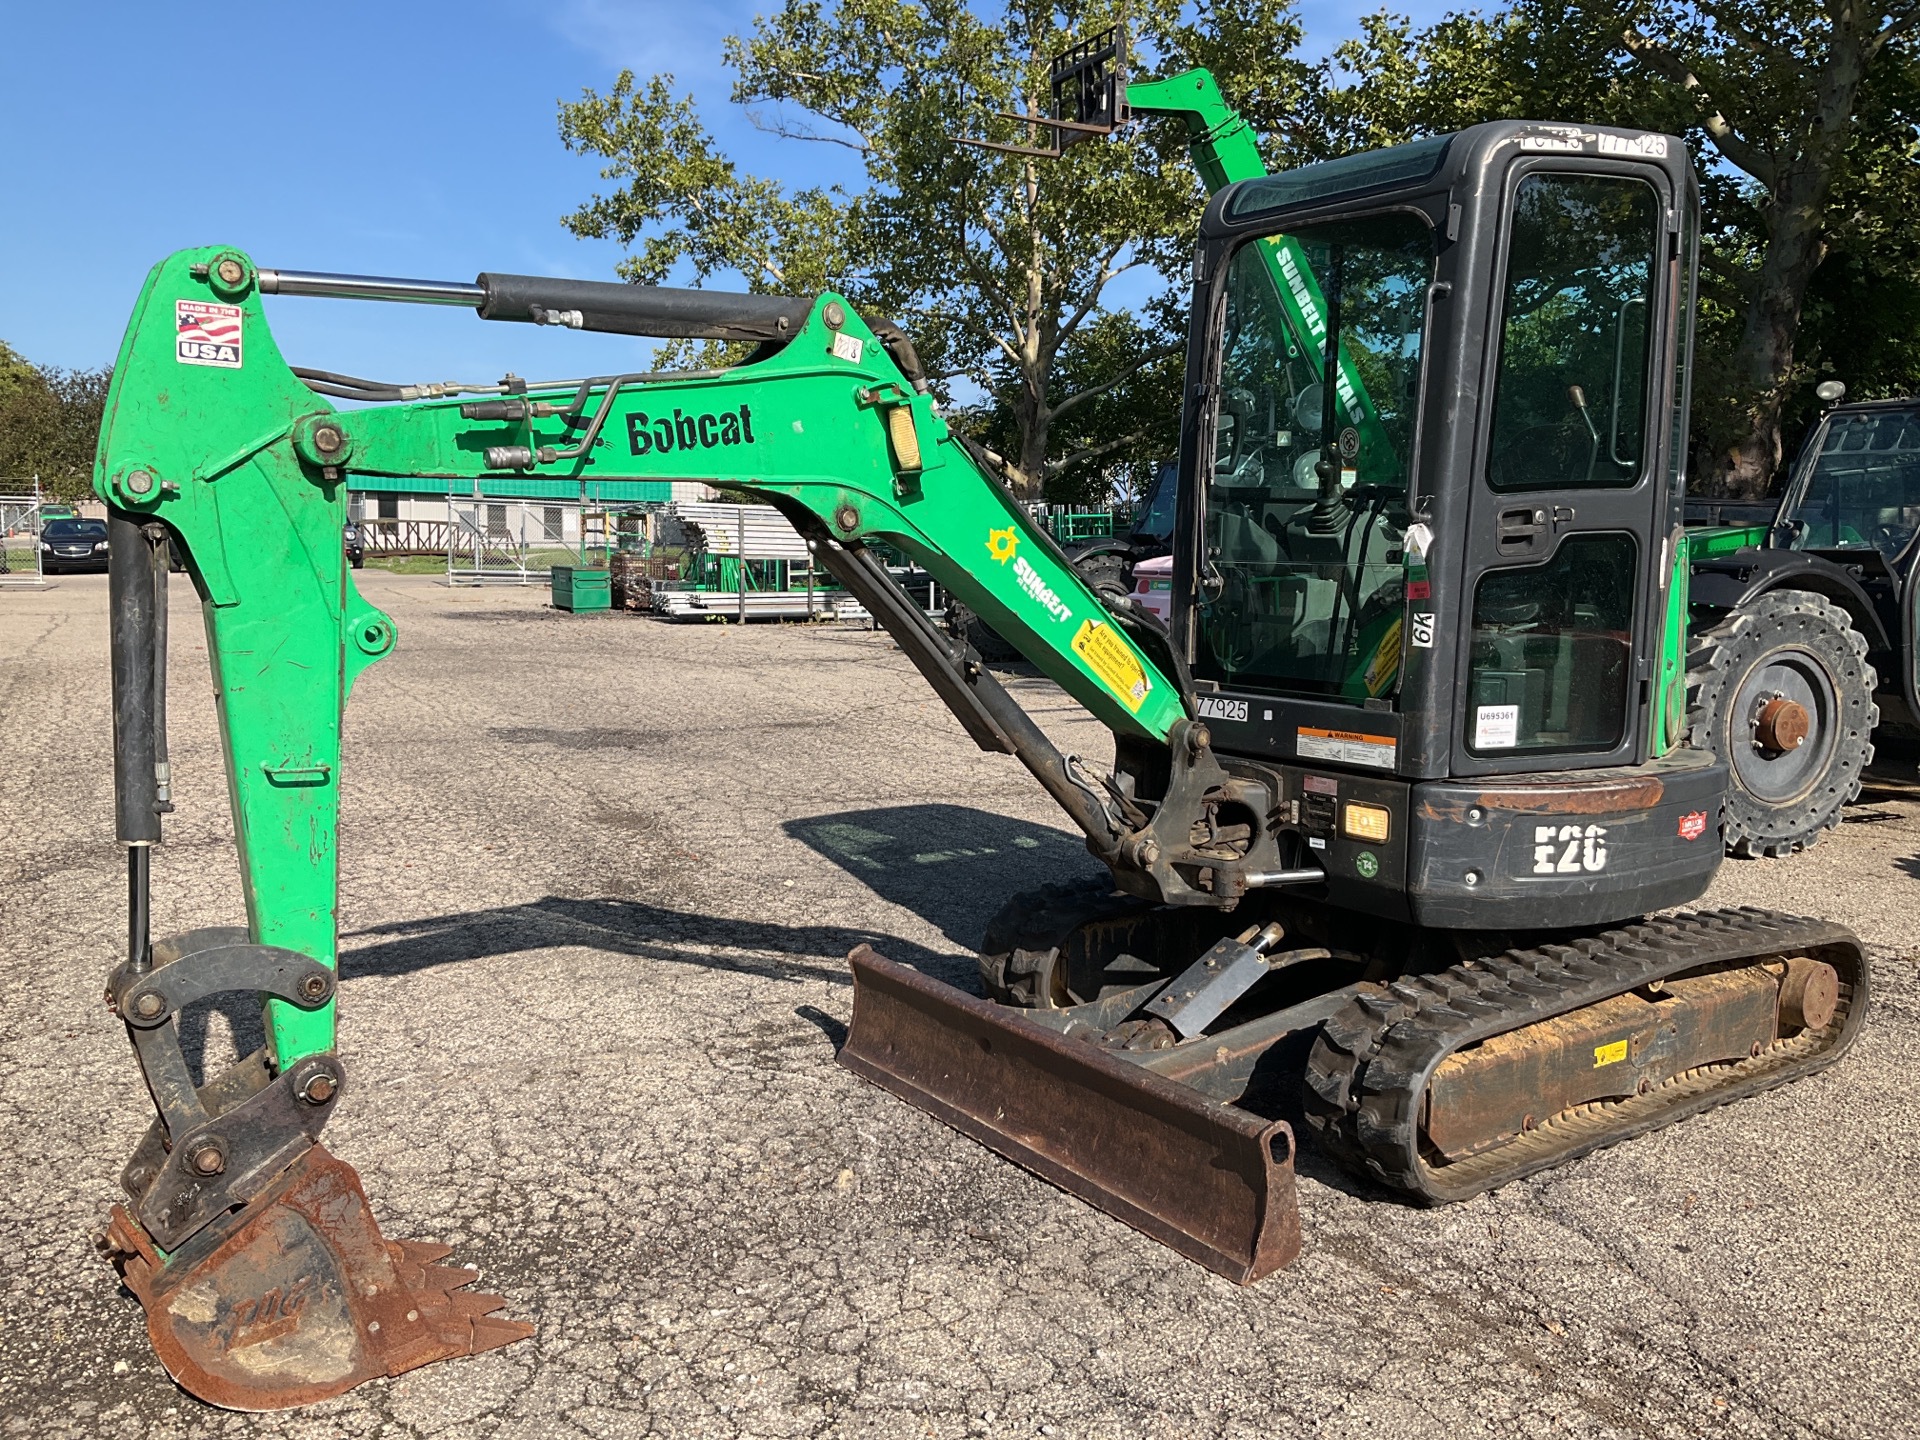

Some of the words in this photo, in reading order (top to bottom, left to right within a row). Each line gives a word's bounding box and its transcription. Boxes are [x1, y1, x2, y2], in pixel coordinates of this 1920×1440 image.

[1275, 247, 1326, 337] SUNBELT
[180, 303, 207, 313] MADE
[221, 308, 237, 316] THE
[181, 342, 237, 362] USA
[625, 403, 755, 456] Bobcat
[1098, 629, 1108, 639] Are
[1104, 637, 1114, 648] you
[1112, 643, 1128, 661] trained
[1100, 645, 1124, 670] equipment?
[1197, 697, 1247, 720] 77925
[1480, 711, 1514, 721] U695361
[1334, 732, 1364, 741] WARNING
